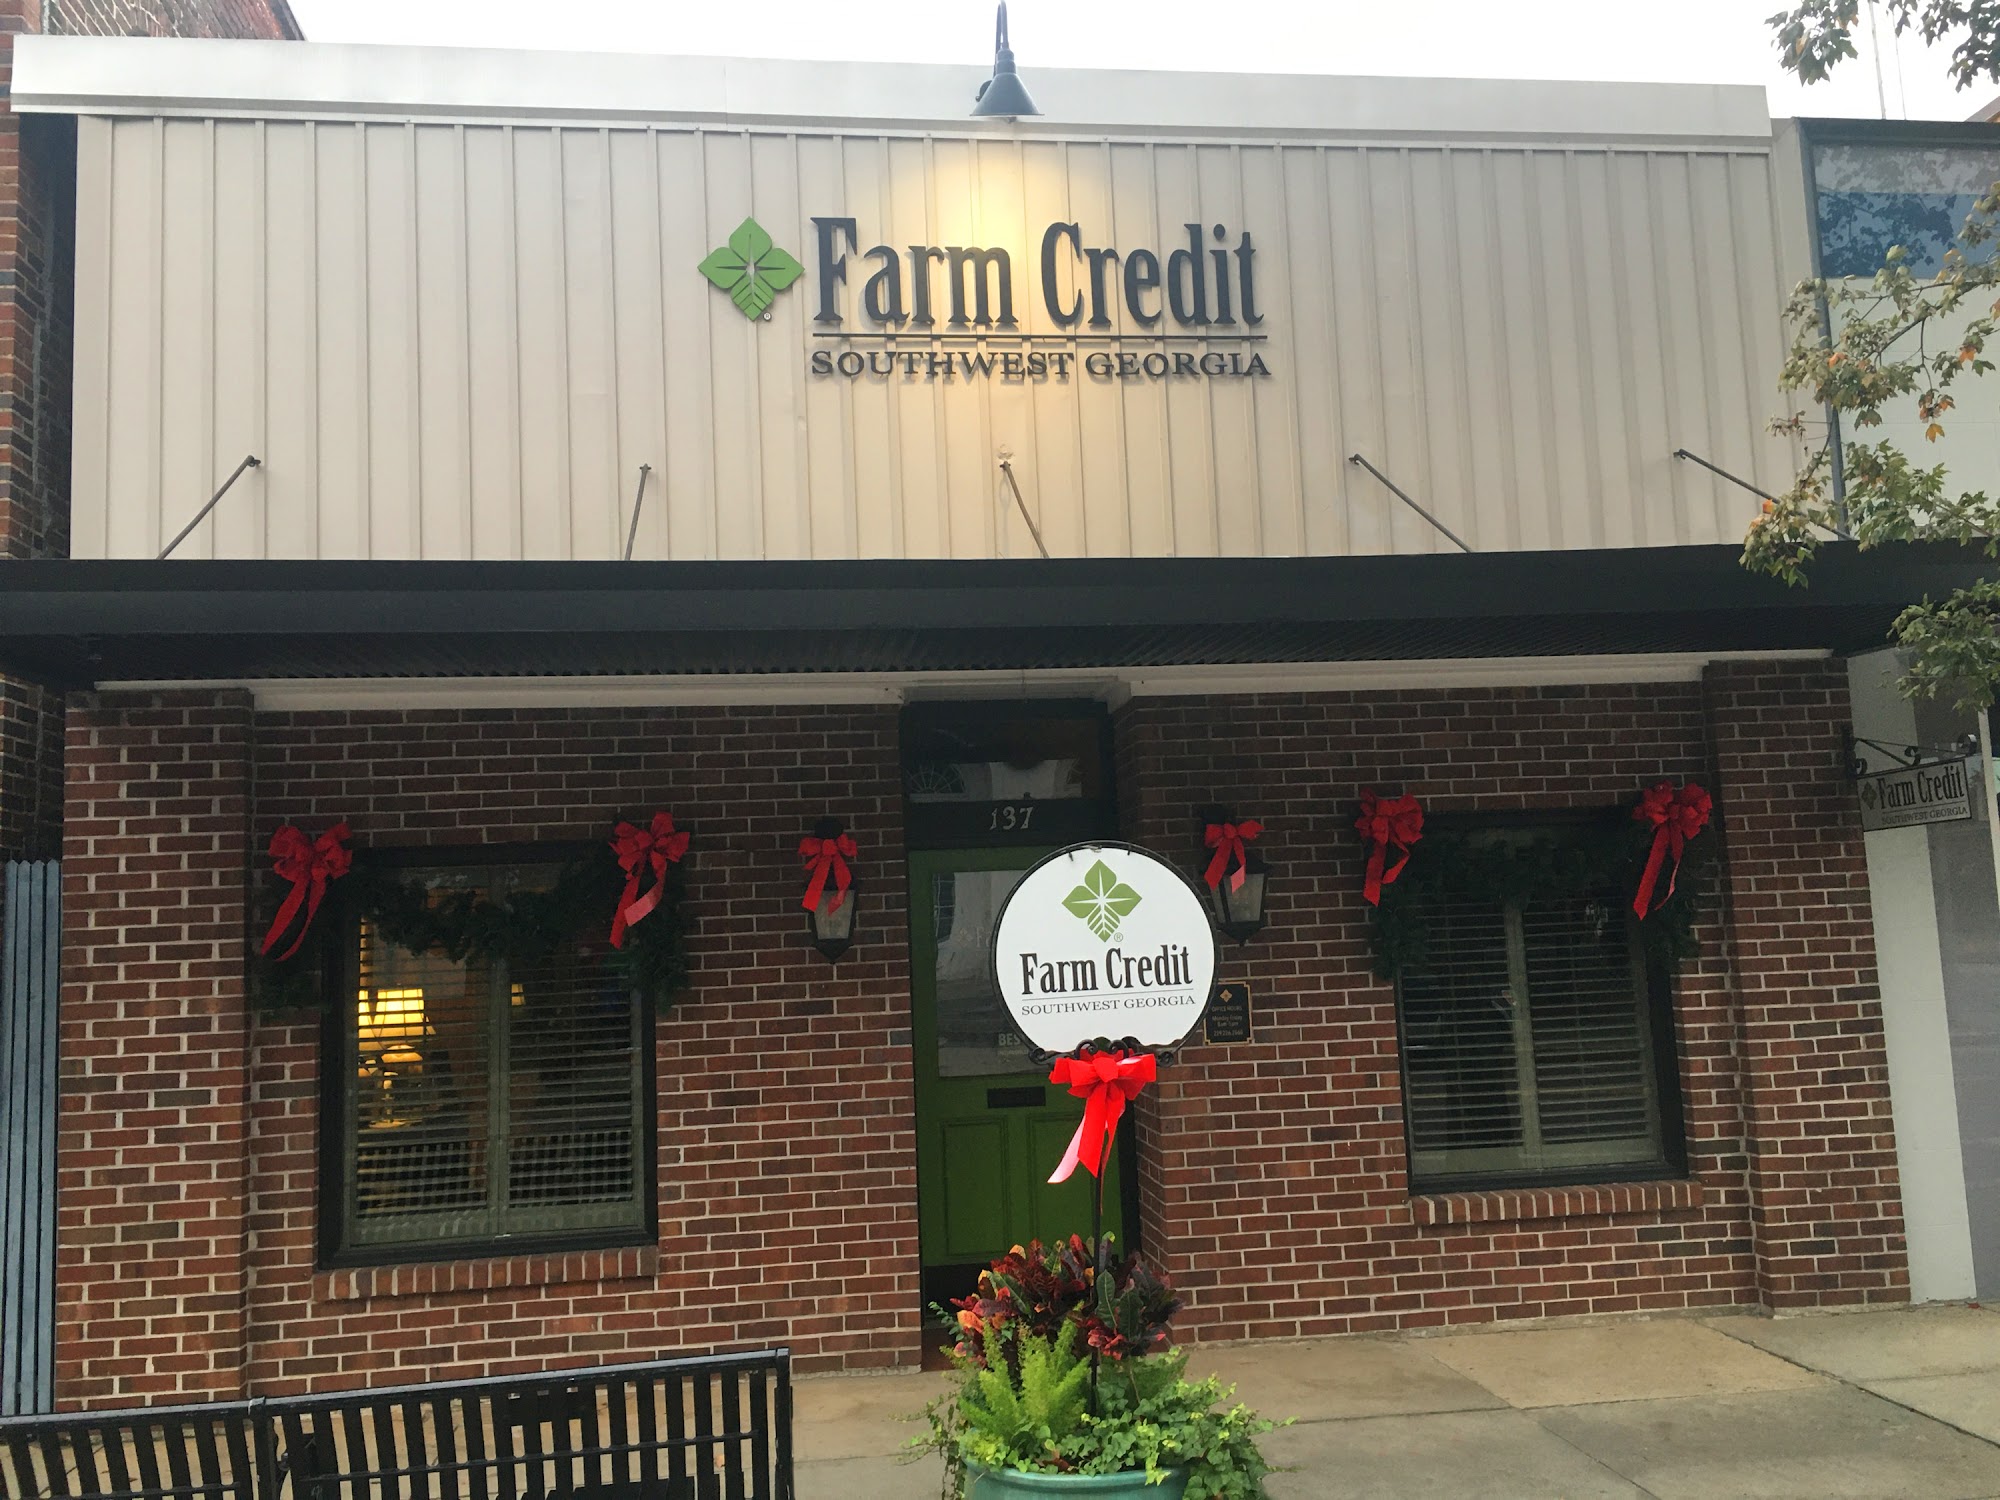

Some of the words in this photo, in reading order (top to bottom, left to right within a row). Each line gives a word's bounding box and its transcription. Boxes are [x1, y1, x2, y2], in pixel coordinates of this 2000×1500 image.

[811, 217, 1018, 324] Farm
[1041, 222, 1264, 325] Credit
[811, 351, 1074, 376] SOUTHWEST
[1085, 352, 1271, 376] GEORGIA
[1876, 777, 1917, 809] Farm
[1917, 765, 1965, 803] Credit
[989, 806, 1034, 830] 137
[1881, 811, 1928, 825] SOUTHWEST
[1930, 806, 1968, 819] GEORGIA
[1020, 953, 1098, 995] Farm
[1105, 944, 1193, 988] Credit
[1021, 1000, 1120, 1016] SOUTHWEST
[1124, 995, 1196, 1009] GEORGIA
